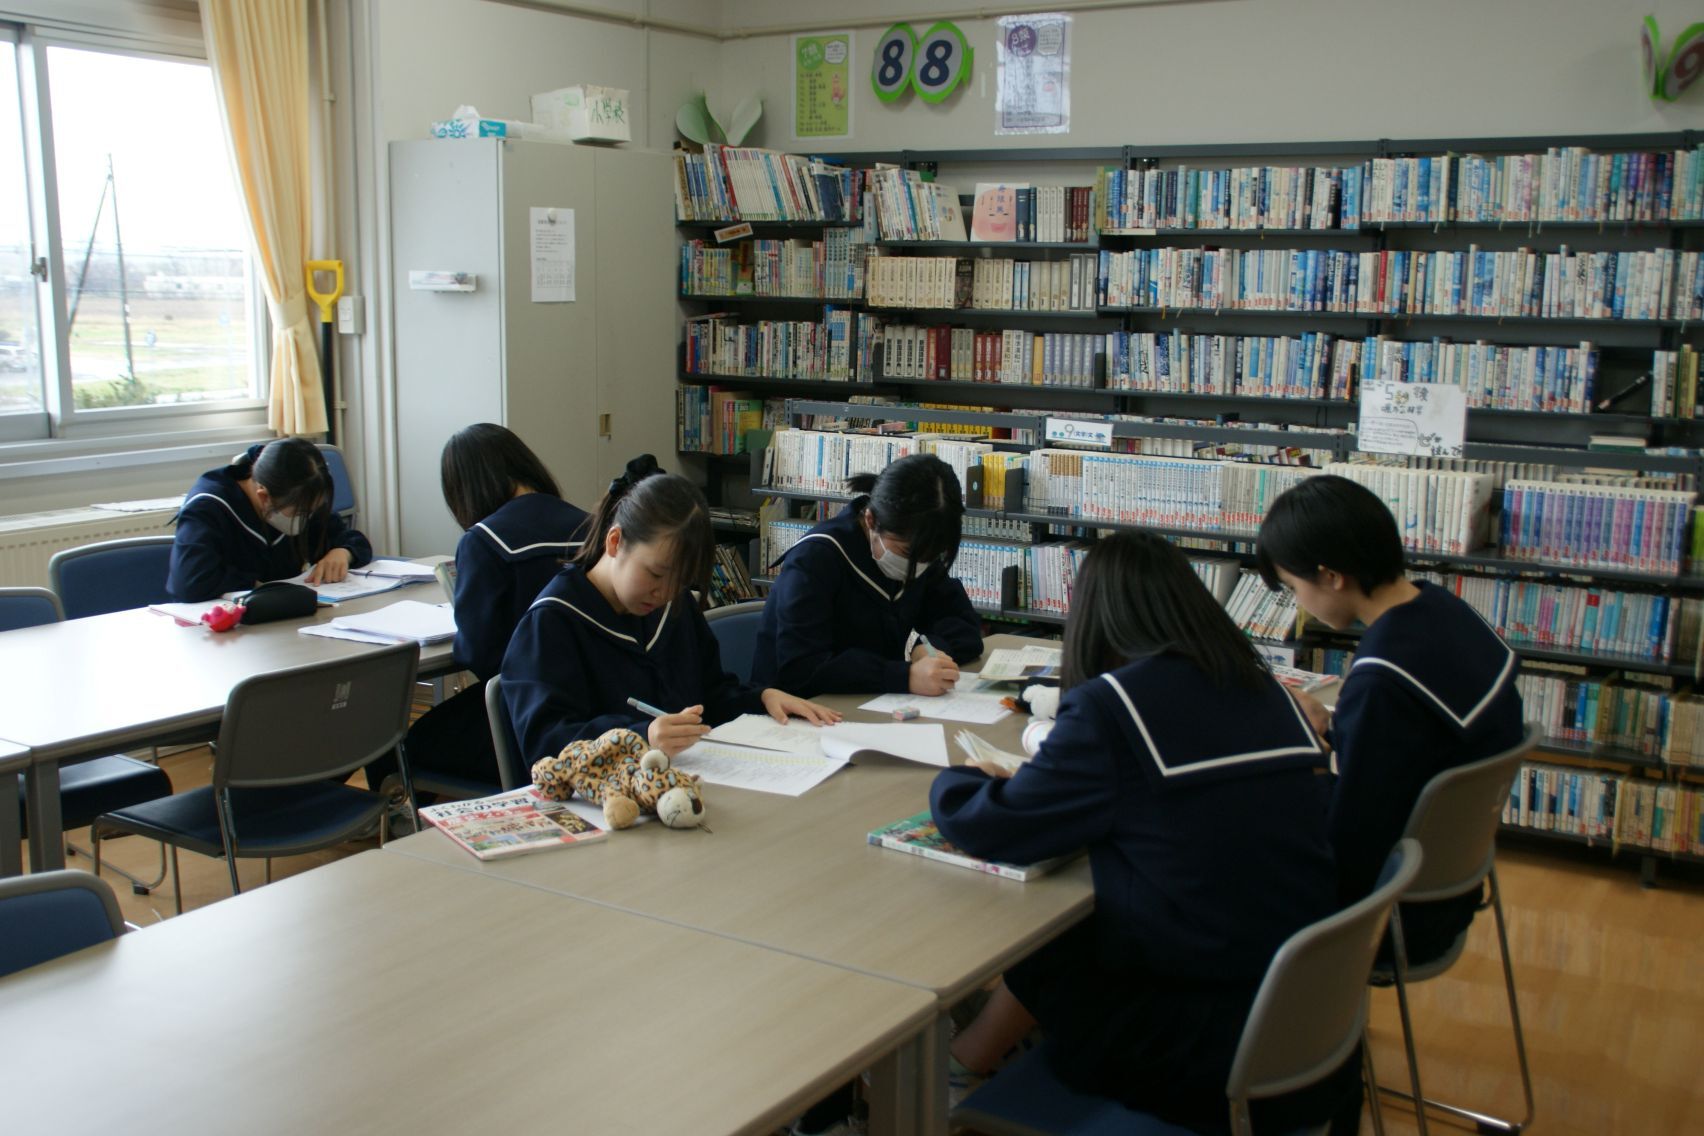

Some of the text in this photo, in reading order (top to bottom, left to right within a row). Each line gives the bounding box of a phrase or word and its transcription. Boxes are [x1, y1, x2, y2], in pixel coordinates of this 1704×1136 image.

[878, 39, 953, 87] 8 8
[590, 96, 626, 126] 小学校
